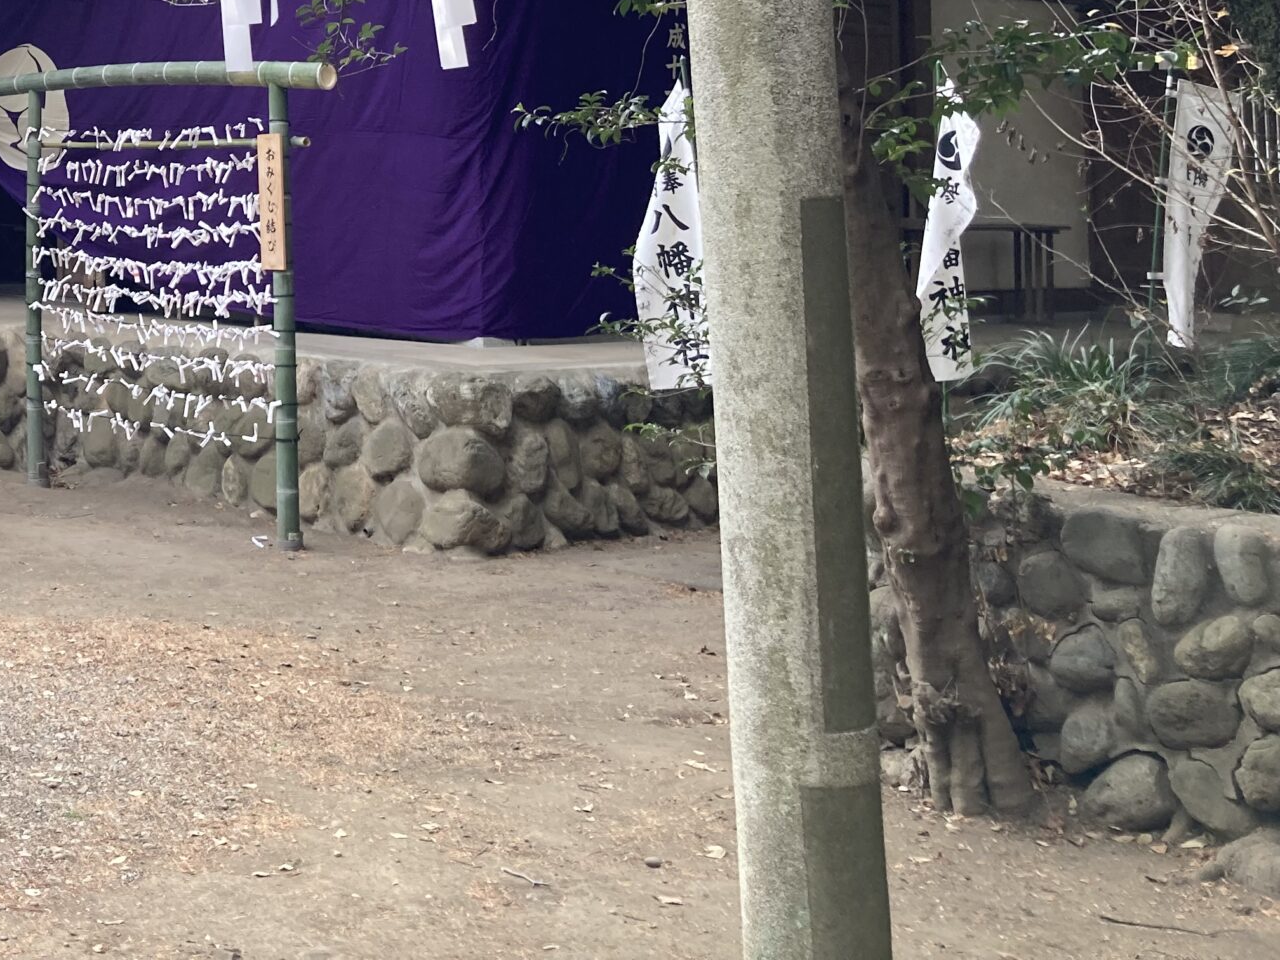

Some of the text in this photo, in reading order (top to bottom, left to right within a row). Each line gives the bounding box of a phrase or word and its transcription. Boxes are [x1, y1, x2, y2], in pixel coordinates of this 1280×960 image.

[265, 148, 277, 254] おみくじ結び
[651, 204, 709, 366] 八幡神社
